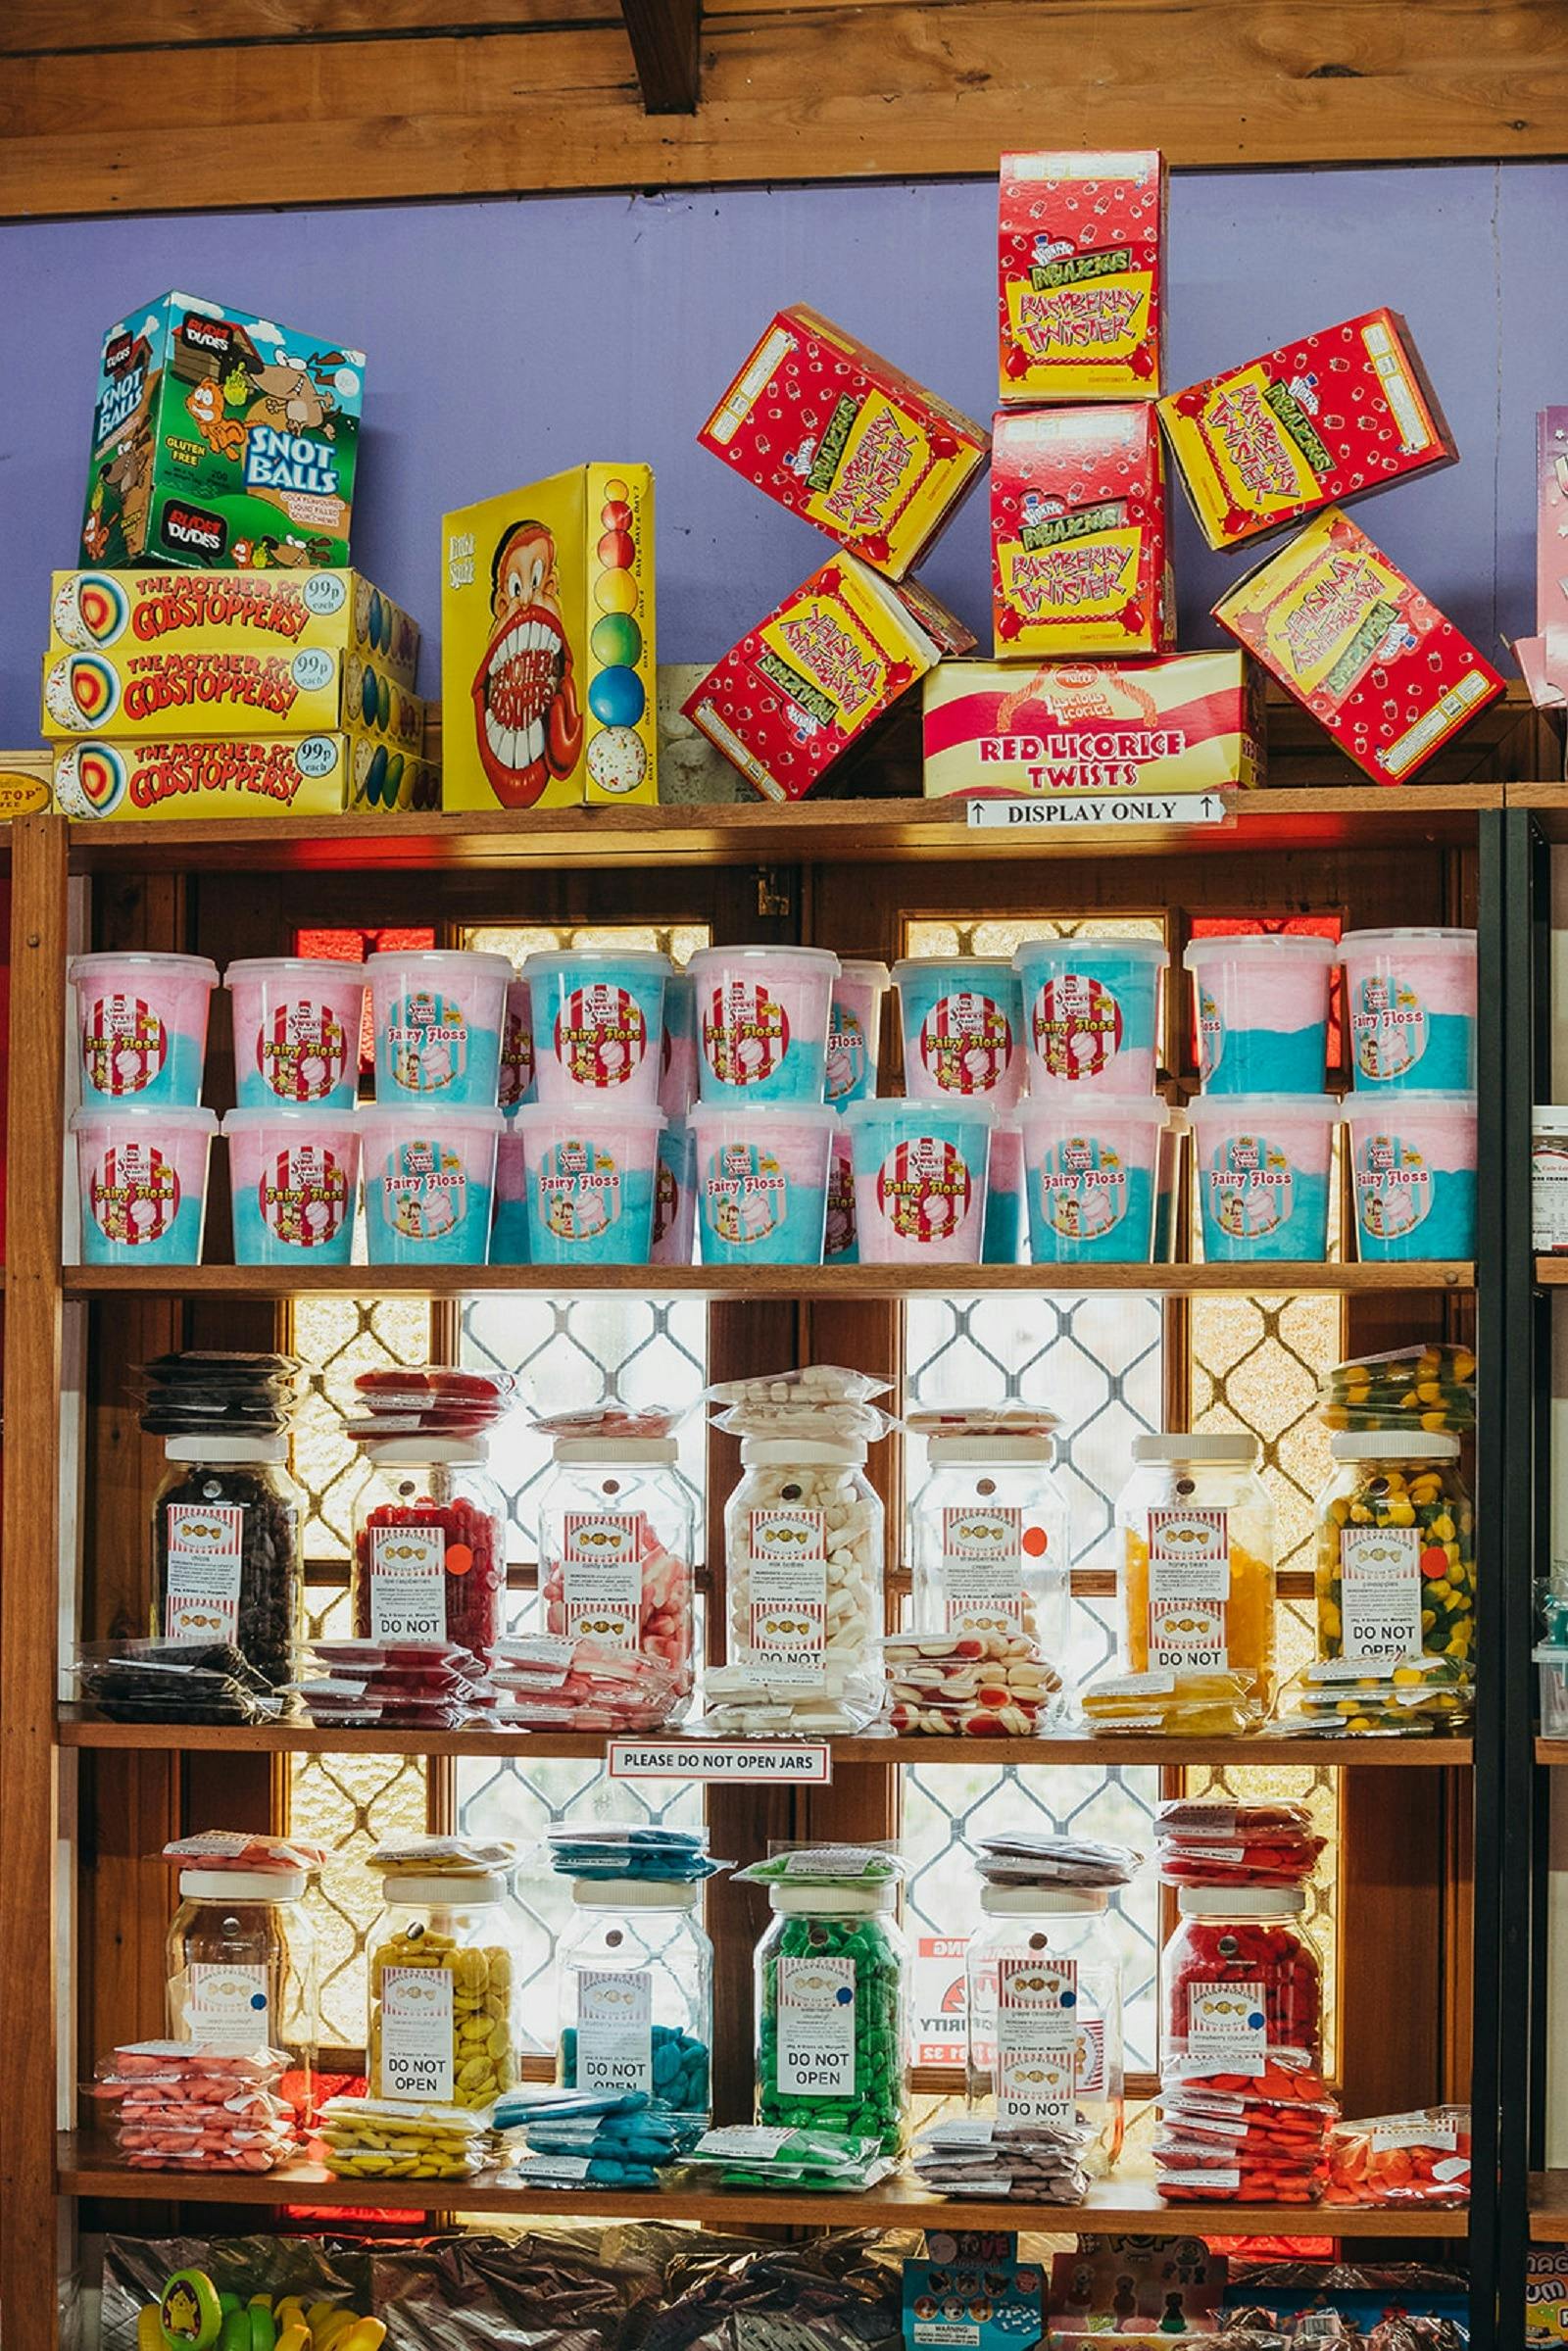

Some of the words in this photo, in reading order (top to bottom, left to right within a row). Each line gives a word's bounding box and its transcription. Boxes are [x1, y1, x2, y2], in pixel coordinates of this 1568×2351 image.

[1019, 289, 1145, 322] RASPBERRY
[185, 328, 229, 351] DUDES
[1017, 314, 1136, 354] TWISTER
[101, 369, 143, 413] SNOT
[97, 386, 144, 441] BALLS
[167, 437, 206, 457] GLUTEN
[251, 427, 336, 468] SNOT
[1207, 392, 1273, 505] TWISTER
[1231, 383, 1301, 498] RASPBERRY
[172, 452, 198, 465] FREE
[824, 406, 900, 521] RASPBERRY
[247, 455, 338, 493] BALLS
[848, 435, 919, 529] TWISTER
[168, 522, 221, 549] DUDES
[1011, 545, 1134, 583] RASPBERRY
[135, 576, 172, 595] THE
[171, 576, 271, 601] MOTHER
[276, 579, 302, 594] OF
[308, 579, 340, 600] 99p
[1009, 574, 1126, 613] TWISTER
[312, 601, 335, 610] each
[132, 592, 311, 643] GOBSTOPPERS!
[127, 654, 164, 675] THE
[163, 653, 262, 677] MOTHER
[266, 656, 292, 669] OF
[297, 656, 328, 674] 99p
[301, 676, 323, 685] each
[123, 670, 299, 720] GOBSTOPPERS!
[133, 744, 172, 762] THE
[170, 742, 267, 764] MOTHER
[271, 744, 296, 757] OF
[302, 743, 331, 761] 99p
[980, 737, 1044, 761] RED
[1051, 730, 1185, 760] LICORICE
[305, 762, 327, 771] each
[1028, 762, 1137, 789] TWISTS
[129, 759, 303, 808] GOBSTOPPERS!
[1008, 804, 1105, 824] DISPLAY
[1112, 802, 1177, 821] ONLY
[388, 1028, 422, 1044] Fairy
[426, 1028, 468, 1042] Floss
[562, 1029, 599, 1043] Fairy
[604, 1027, 641, 1042] Floss
[706, 1025, 737, 1040] Fairy
[741, 1024, 782, 1038] Floss
[1036, 1019, 1073, 1035] Fairy
[1076, 1019, 1115, 1034] Floss
[86, 1036, 116, 1053] Fairy
[119, 1035, 160, 1051] Floss
[265, 1042, 300, 1059] Fairy
[302, 1042, 342, 1056] Floss
[830, 1034, 863, 1050] Floss
[926, 1036, 964, 1051] Fairy
[969, 1035, 1006, 1049] Floss
[384, 1175, 421, 1193] Fairy
[424, 1173, 466, 1189] Floss
[540, 1175, 578, 1193] Fairy
[579, 1173, 621, 1190] Floss
[707, 1177, 740, 1195] Fairy
[744, 1176, 786, 1193] Floss
[1043, 1173, 1078, 1193] Fairy
[1085, 1172, 1125, 1188] Floss
[1211, 1171, 1245, 1188] Fairy
[1250, 1170, 1293, 1186] Floss
[1357, 1171, 1384, 1188] Fairy
[1387, 1169, 1428, 1186] Floss
[94, 1185, 129, 1202] Fairy
[133, 1185, 173, 1200] Floss
[266, 1187, 304, 1203] Fairy
[306, 1187, 344, 1201] Floss
[884, 1180, 924, 1196] Fairy
[929, 1180, 965, 1196] Floss
[381, 1620, 402, 1634] DO
[406, 1619, 439, 1633] NOT
[1353, 1627, 1376, 1640] DO
[1381, 1626, 1415, 1639] NOT
[760, 1652, 783, 1663] DO
[787, 1652, 820, 1664] NOT
[1159, 1651, 1183, 1665] DO
[1187, 1651, 1221, 1665] NOT
[1361, 1644, 1406, 1654] OPEN
[624, 1753, 674, 1767] PLEASE
[678, 1754, 699, 1767] DO
[704, 1755, 733, 1768] NOT
[737, 1756, 776, 1769] OPEN
[779, 1756, 812, 1769] JARS
[389, 2059, 409, 2073] DO
[414, 2060, 446, 2073] NOT
[788, 2053, 810, 2067] DO
[814, 2053, 850, 2067] NOT
[587, 2063, 608, 2077] DO
[612, 2064, 647, 2077] NOT
[796, 2071, 841, 2085] OPEN
[395, 2077, 437, 2091] OPEN
[1007, 2102, 1031, 2116] DO
[1036, 2102, 1070, 2116] NOT
